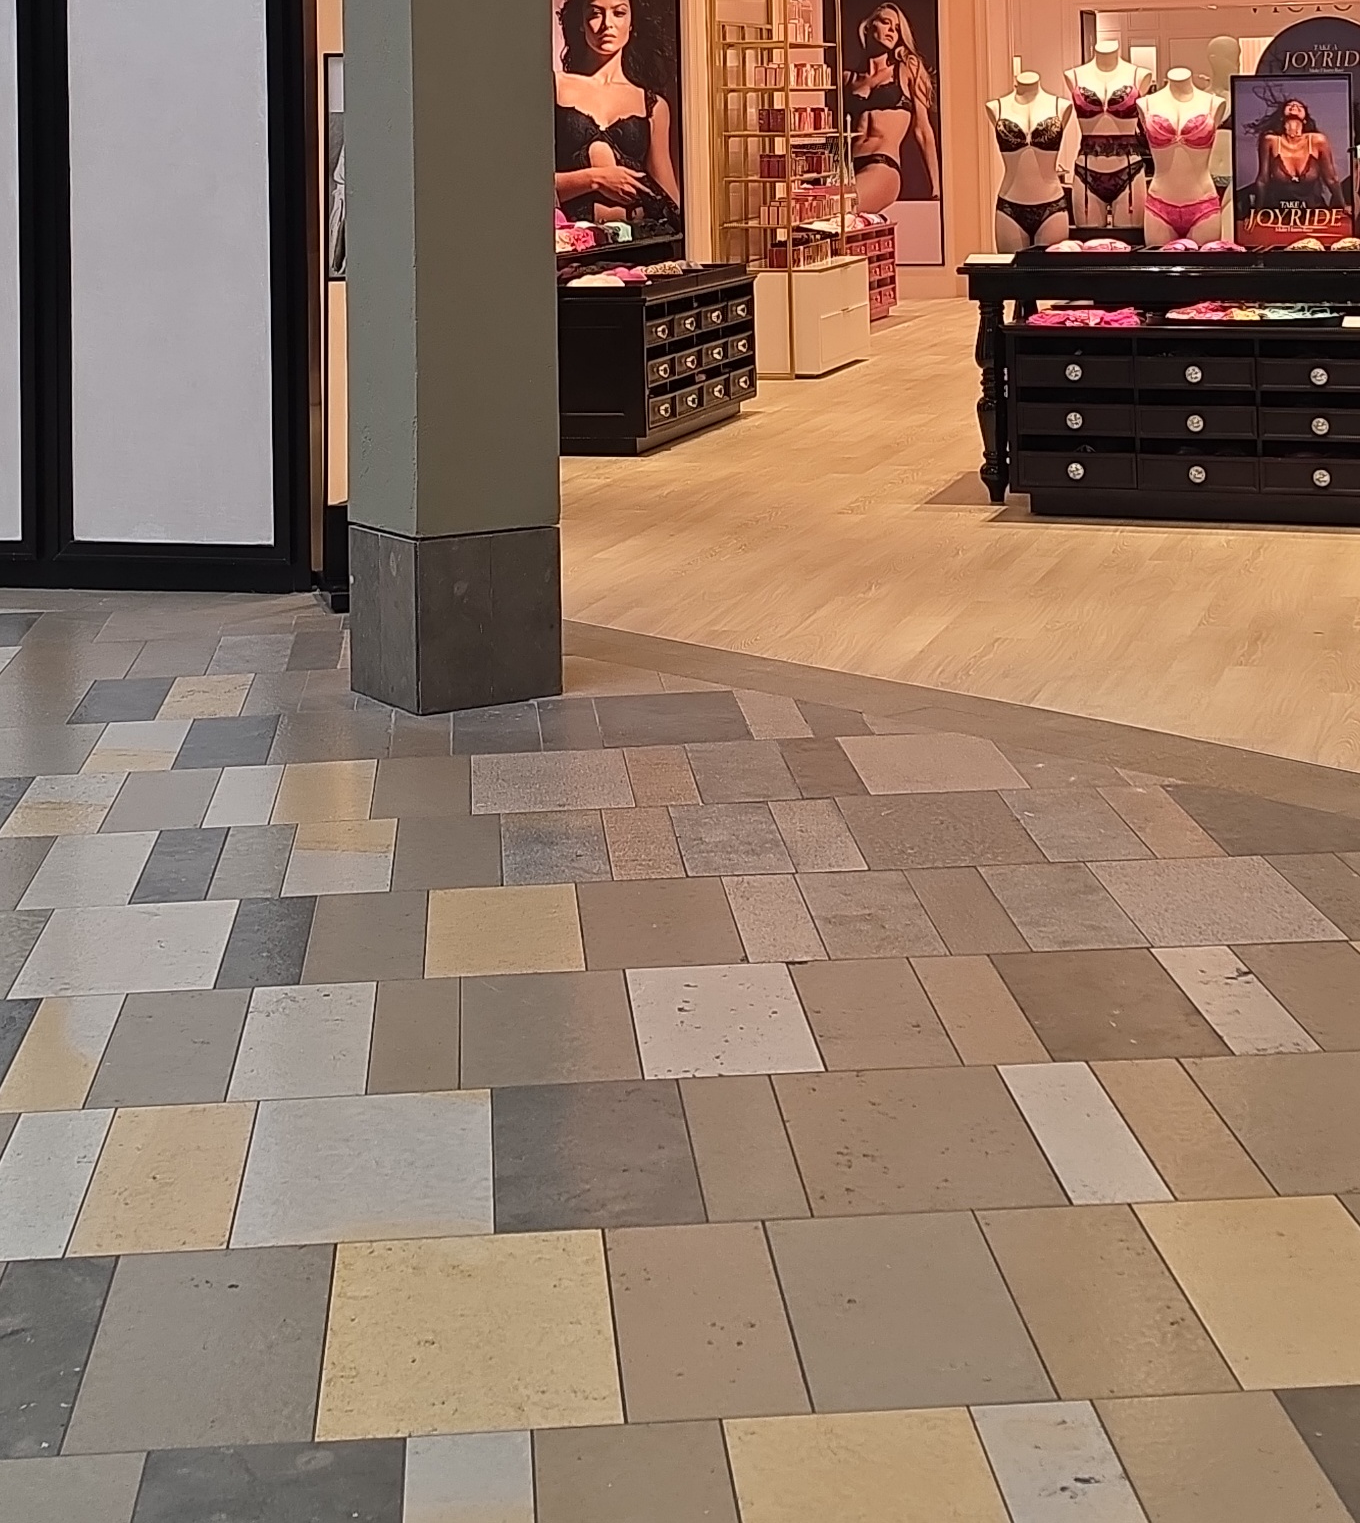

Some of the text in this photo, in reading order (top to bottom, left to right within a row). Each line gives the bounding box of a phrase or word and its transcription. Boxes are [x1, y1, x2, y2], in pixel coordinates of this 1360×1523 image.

[1280, 201, 1307, 209] TAKE A
[1245, 208, 1344, 232] JOYRIDE
